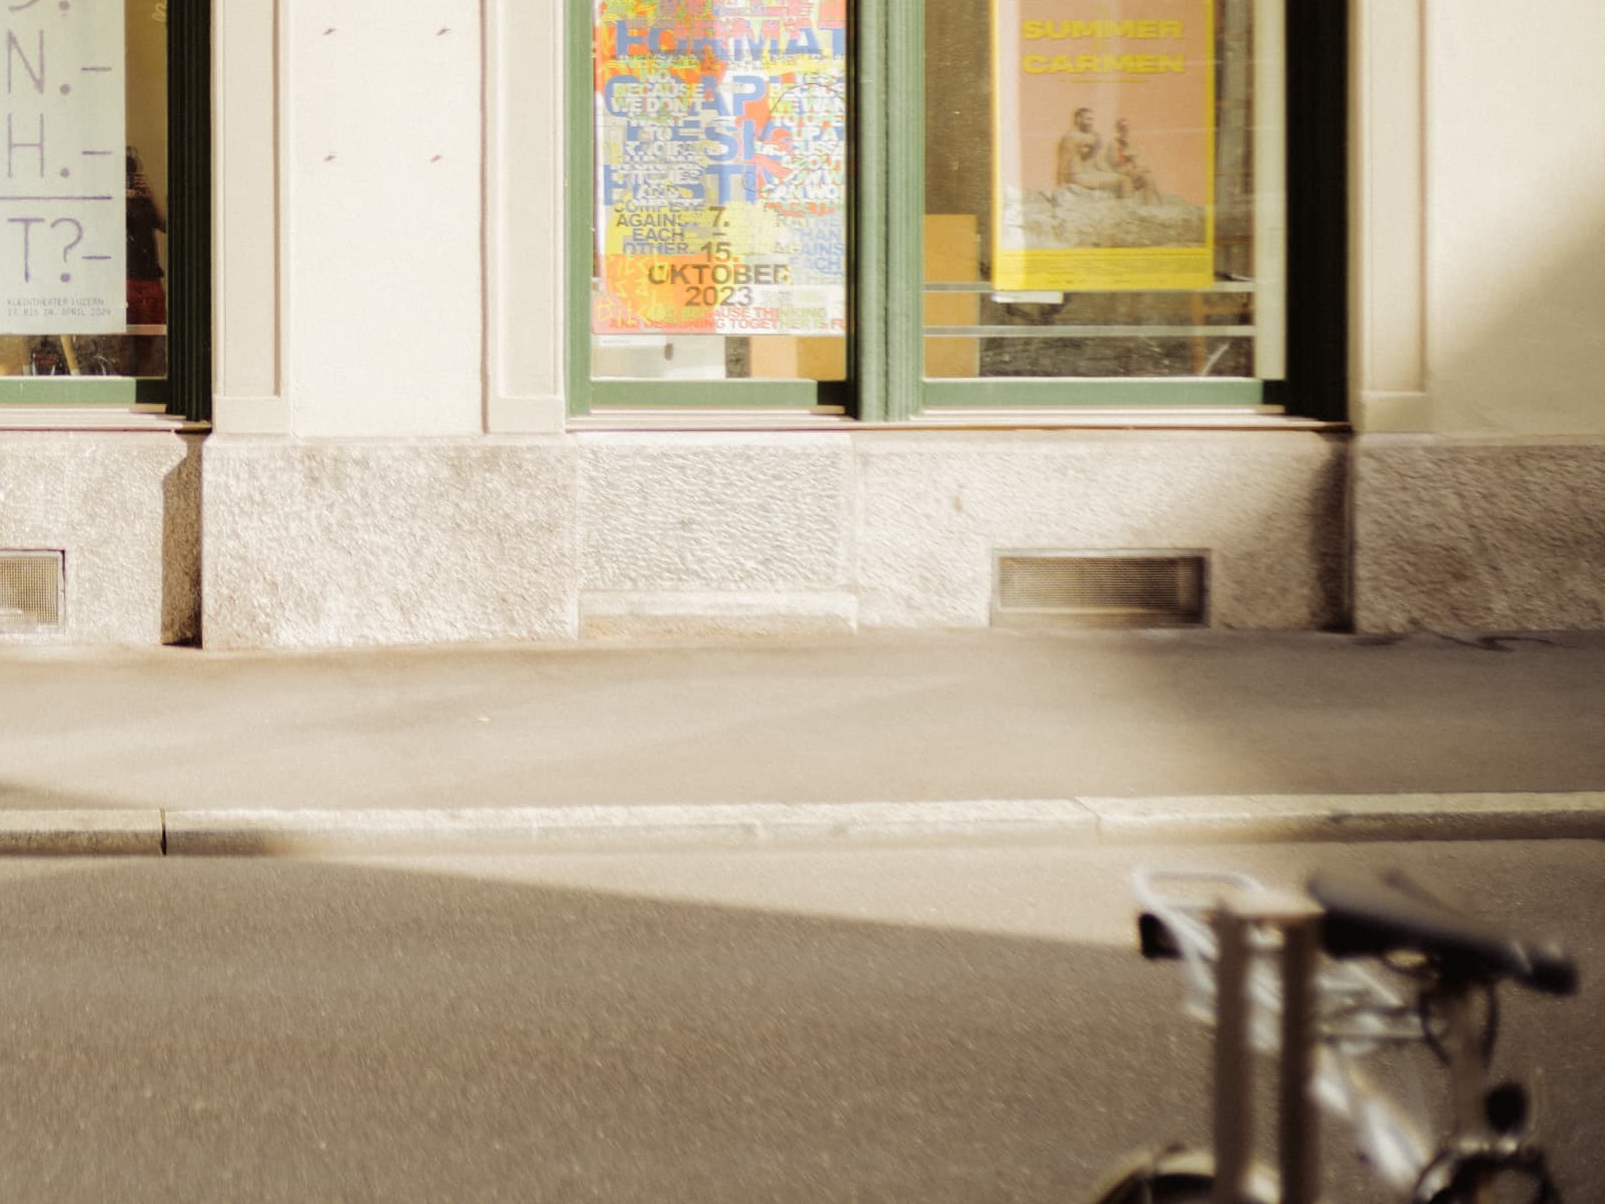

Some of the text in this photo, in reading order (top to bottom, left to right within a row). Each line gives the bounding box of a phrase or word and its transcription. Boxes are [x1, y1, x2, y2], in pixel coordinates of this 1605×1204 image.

[1022, 18, 1185, 40] SUMMER
[1022, 54, 1187, 75] CARMEN
[632, 227, 685, 242] EACH
[700, 241, 739, 263] 15.
[685, 286, 753, 307] 2023
